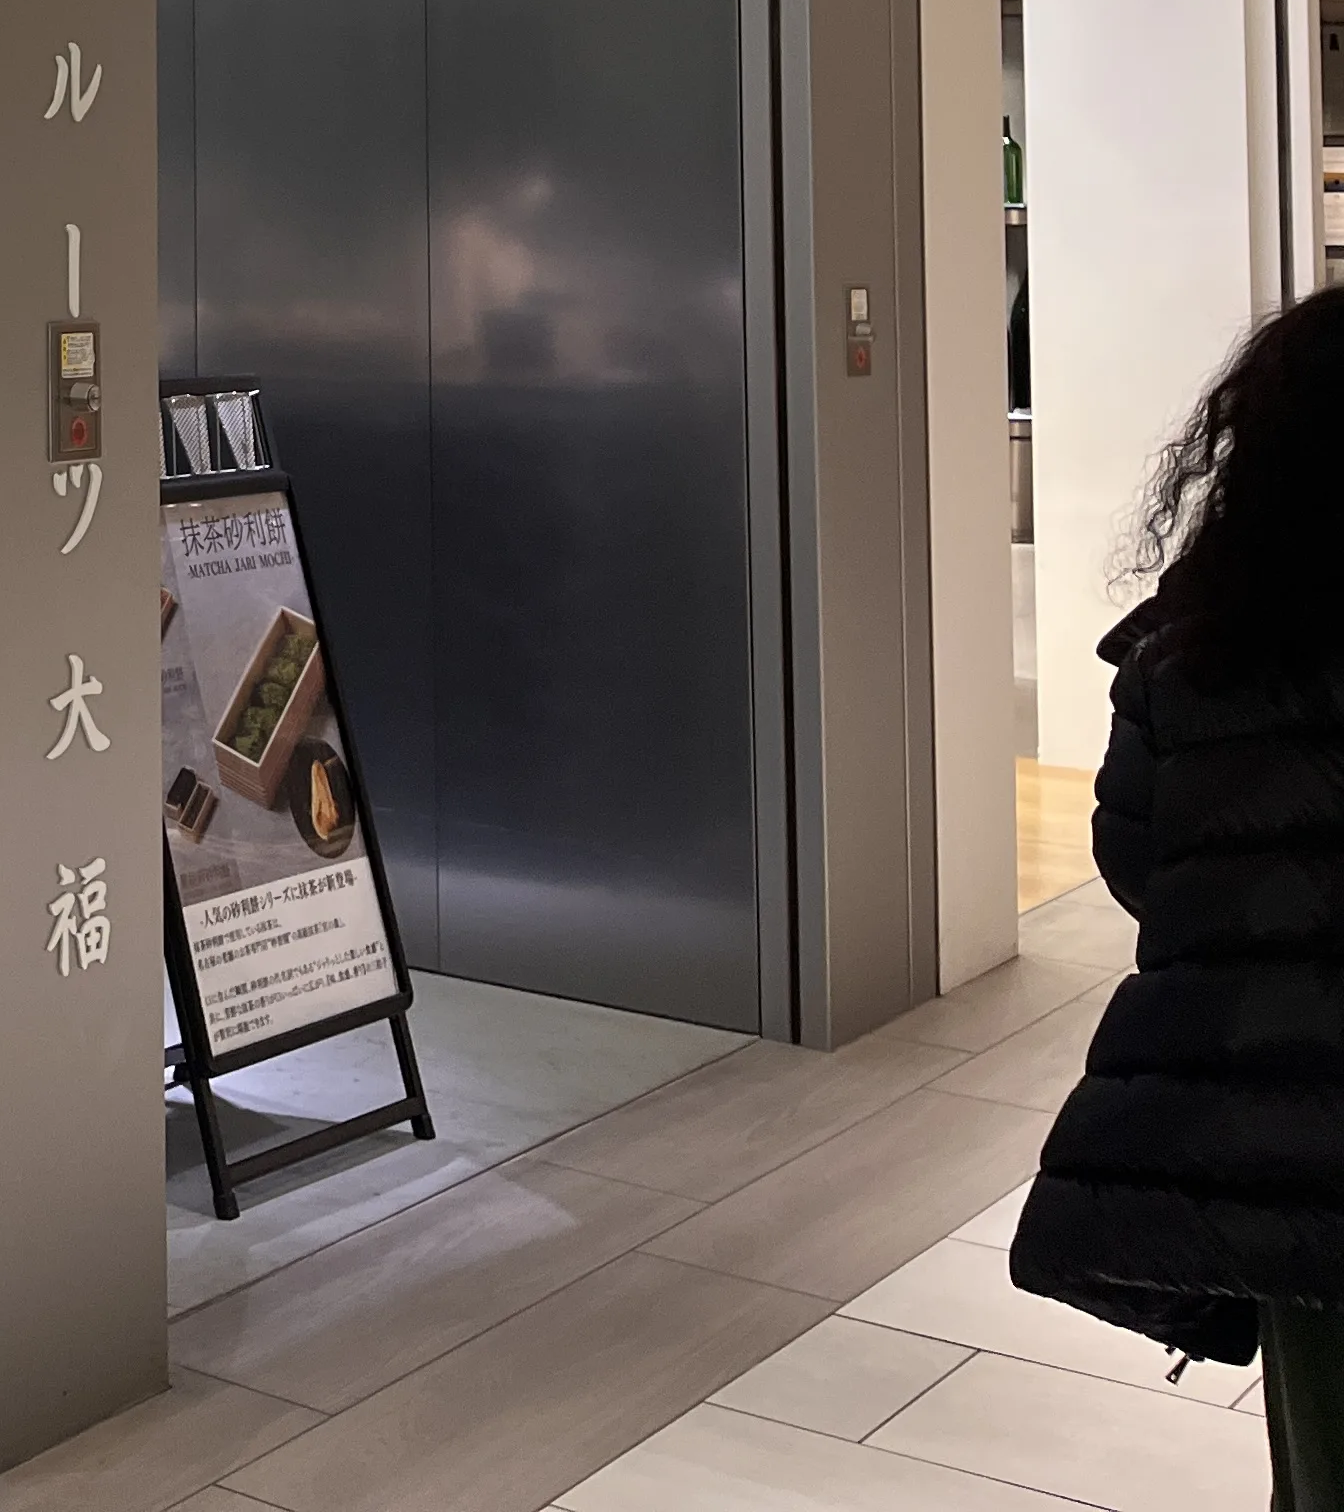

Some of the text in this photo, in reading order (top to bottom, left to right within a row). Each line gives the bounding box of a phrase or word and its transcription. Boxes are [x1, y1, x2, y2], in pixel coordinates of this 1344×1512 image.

[179, 508, 288, 557] 抹茶砂利餅
[235, 555, 257, 572] JARI
